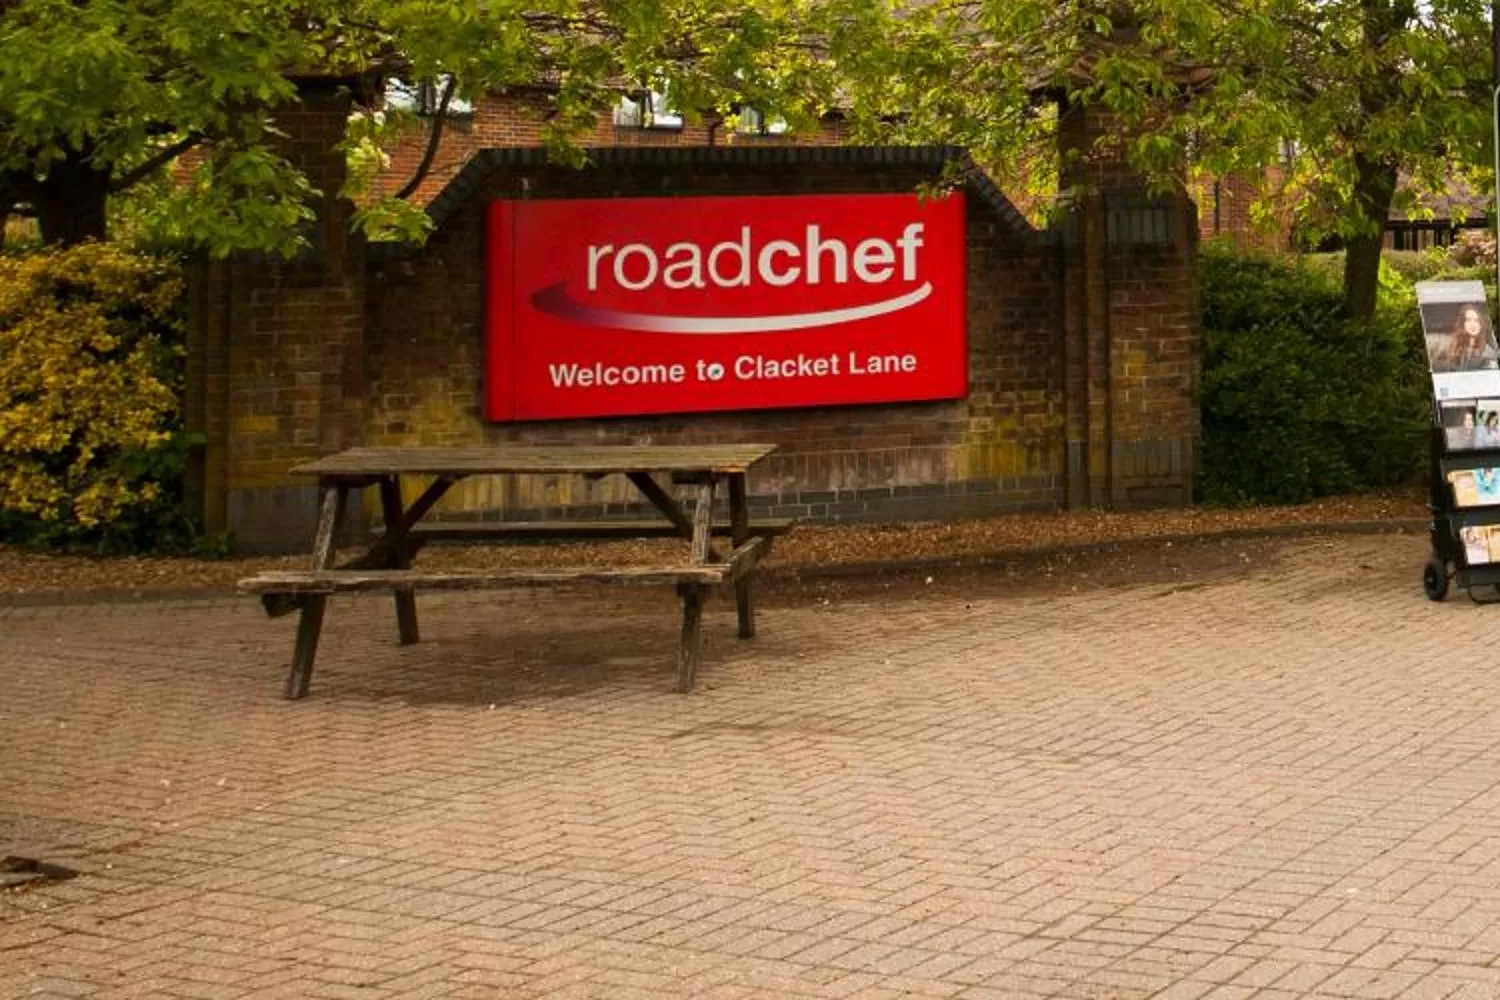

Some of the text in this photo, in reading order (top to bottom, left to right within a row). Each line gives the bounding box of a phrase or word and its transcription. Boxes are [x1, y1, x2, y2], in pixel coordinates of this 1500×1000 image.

[587, 222, 925, 292] roadchef
[549, 352, 918, 388] Welcome to Clacket Lane
